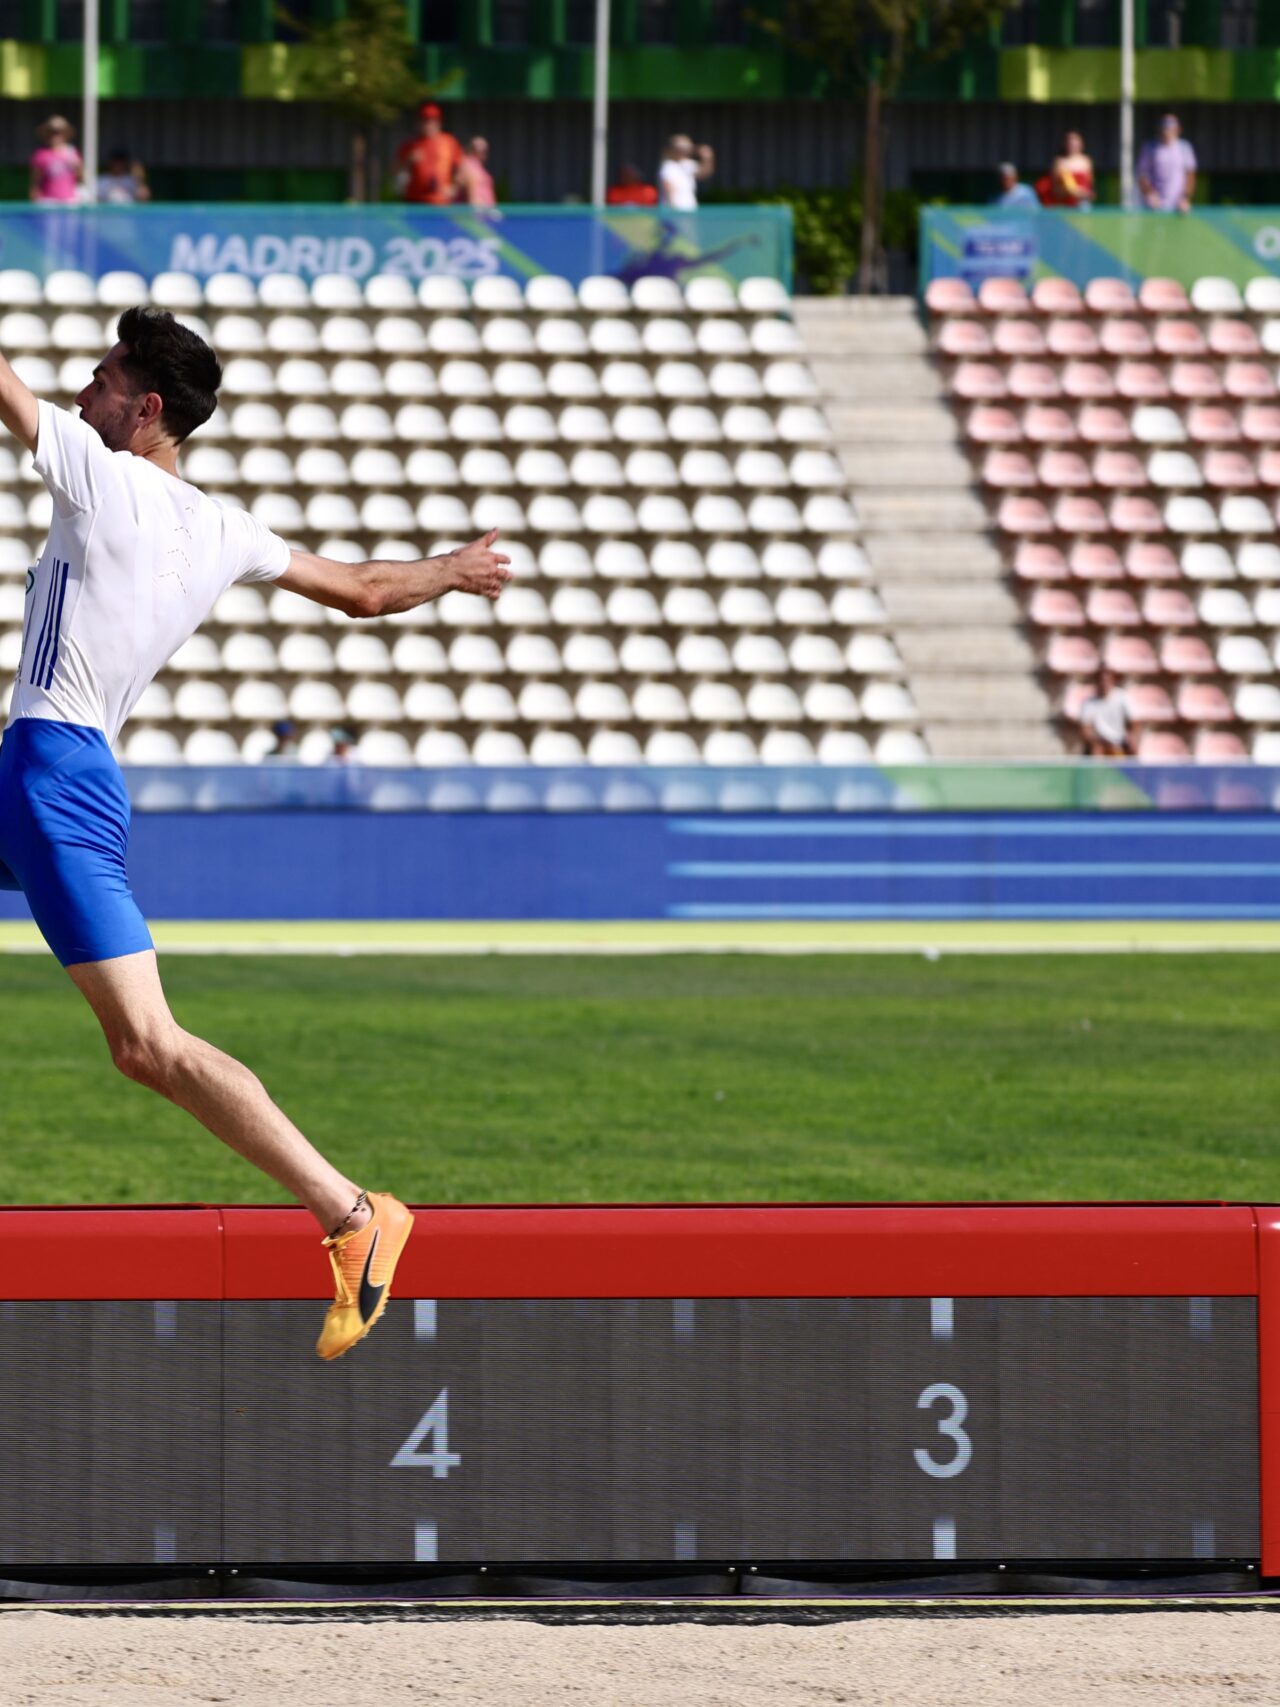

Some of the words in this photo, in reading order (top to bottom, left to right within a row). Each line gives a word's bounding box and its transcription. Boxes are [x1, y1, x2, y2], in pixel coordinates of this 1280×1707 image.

[172, 234, 375, 277] MADRID
[380, 237, 500, 277] 2025
[389, 1388, 462, 1478] 4
[913, 1383, 973, 1478] 3
